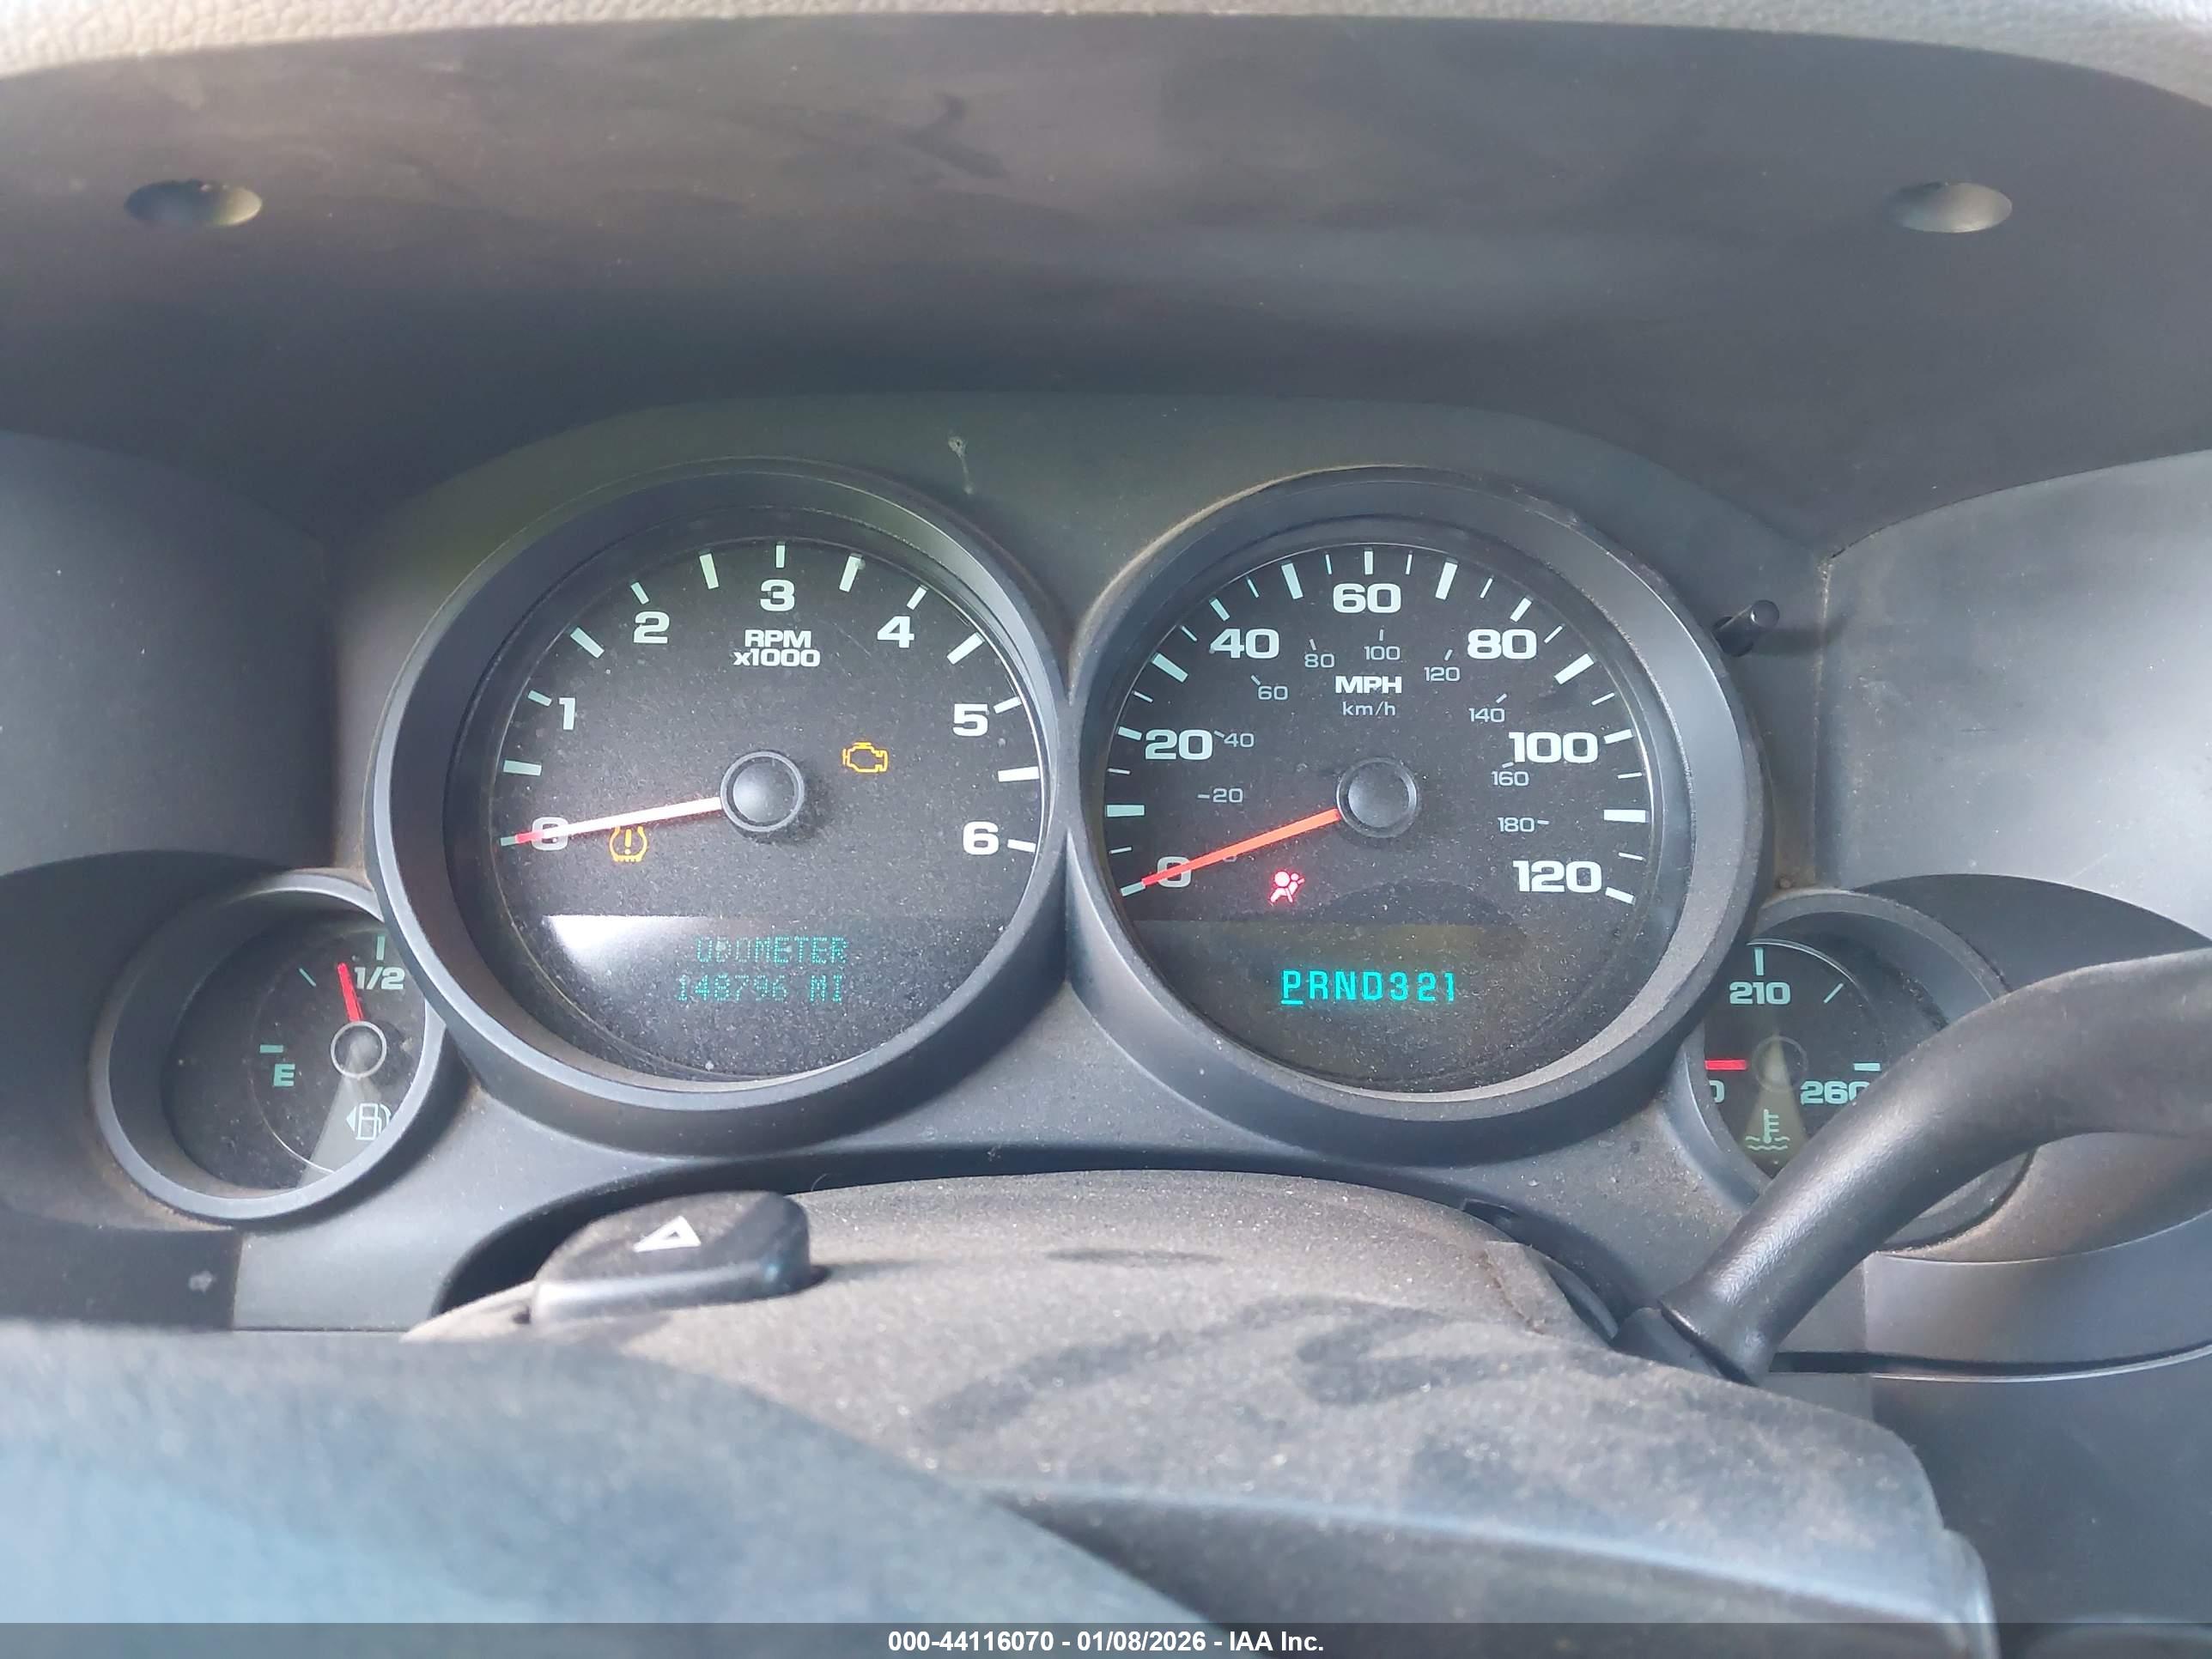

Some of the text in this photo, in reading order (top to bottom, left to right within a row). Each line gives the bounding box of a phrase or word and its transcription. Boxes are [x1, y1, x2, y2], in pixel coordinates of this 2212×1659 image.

[760, 580, 795, 611] 3
[1333, 583, 1401, 614] 60
[634, 611, 670, 644] 2
[744, 629, 811, 648] RPM
[878, 616, 915, 648] 4
[1210, 628, 1279, 659] 40
[1364, 645, 1401, 661] 100
[1467, 629, 1537, 659] 80
[733, 649, 820, 667] x1000
[1304, 653, 1335, 669] 80
[1334, 676, 1401, 693] MPH
[1425, 666, 1460, 683] 120
[1258, 685, 1288, 701] 60
[559, 696, 574, 730] 1
[953, 703, 988, 737] 5
[1342, 700, 1395, 717] km/h
[1469, 707, 1505, 723] 140
[1145, 729, 1212, 760] 20
[1224, 732, 1255, 748] 40
[1509, 732, 1598, 763] 100
[1491, 770, 1528, 787] 160
[1212, 788, 1243, 803] 20
[1498, 817, 1535, 833] 180
[963, 822, 999, 855] 6
[1513, 860, 1601, 893] 120
[696, 937, 848, 963] ODOMETER
[355, 967, 404, 990] 1/2
[678, 975, 842, 1001] 148796 MI
[1729, 981, 1790, 1005] 210
[273, 1063, 295, 1087] E
